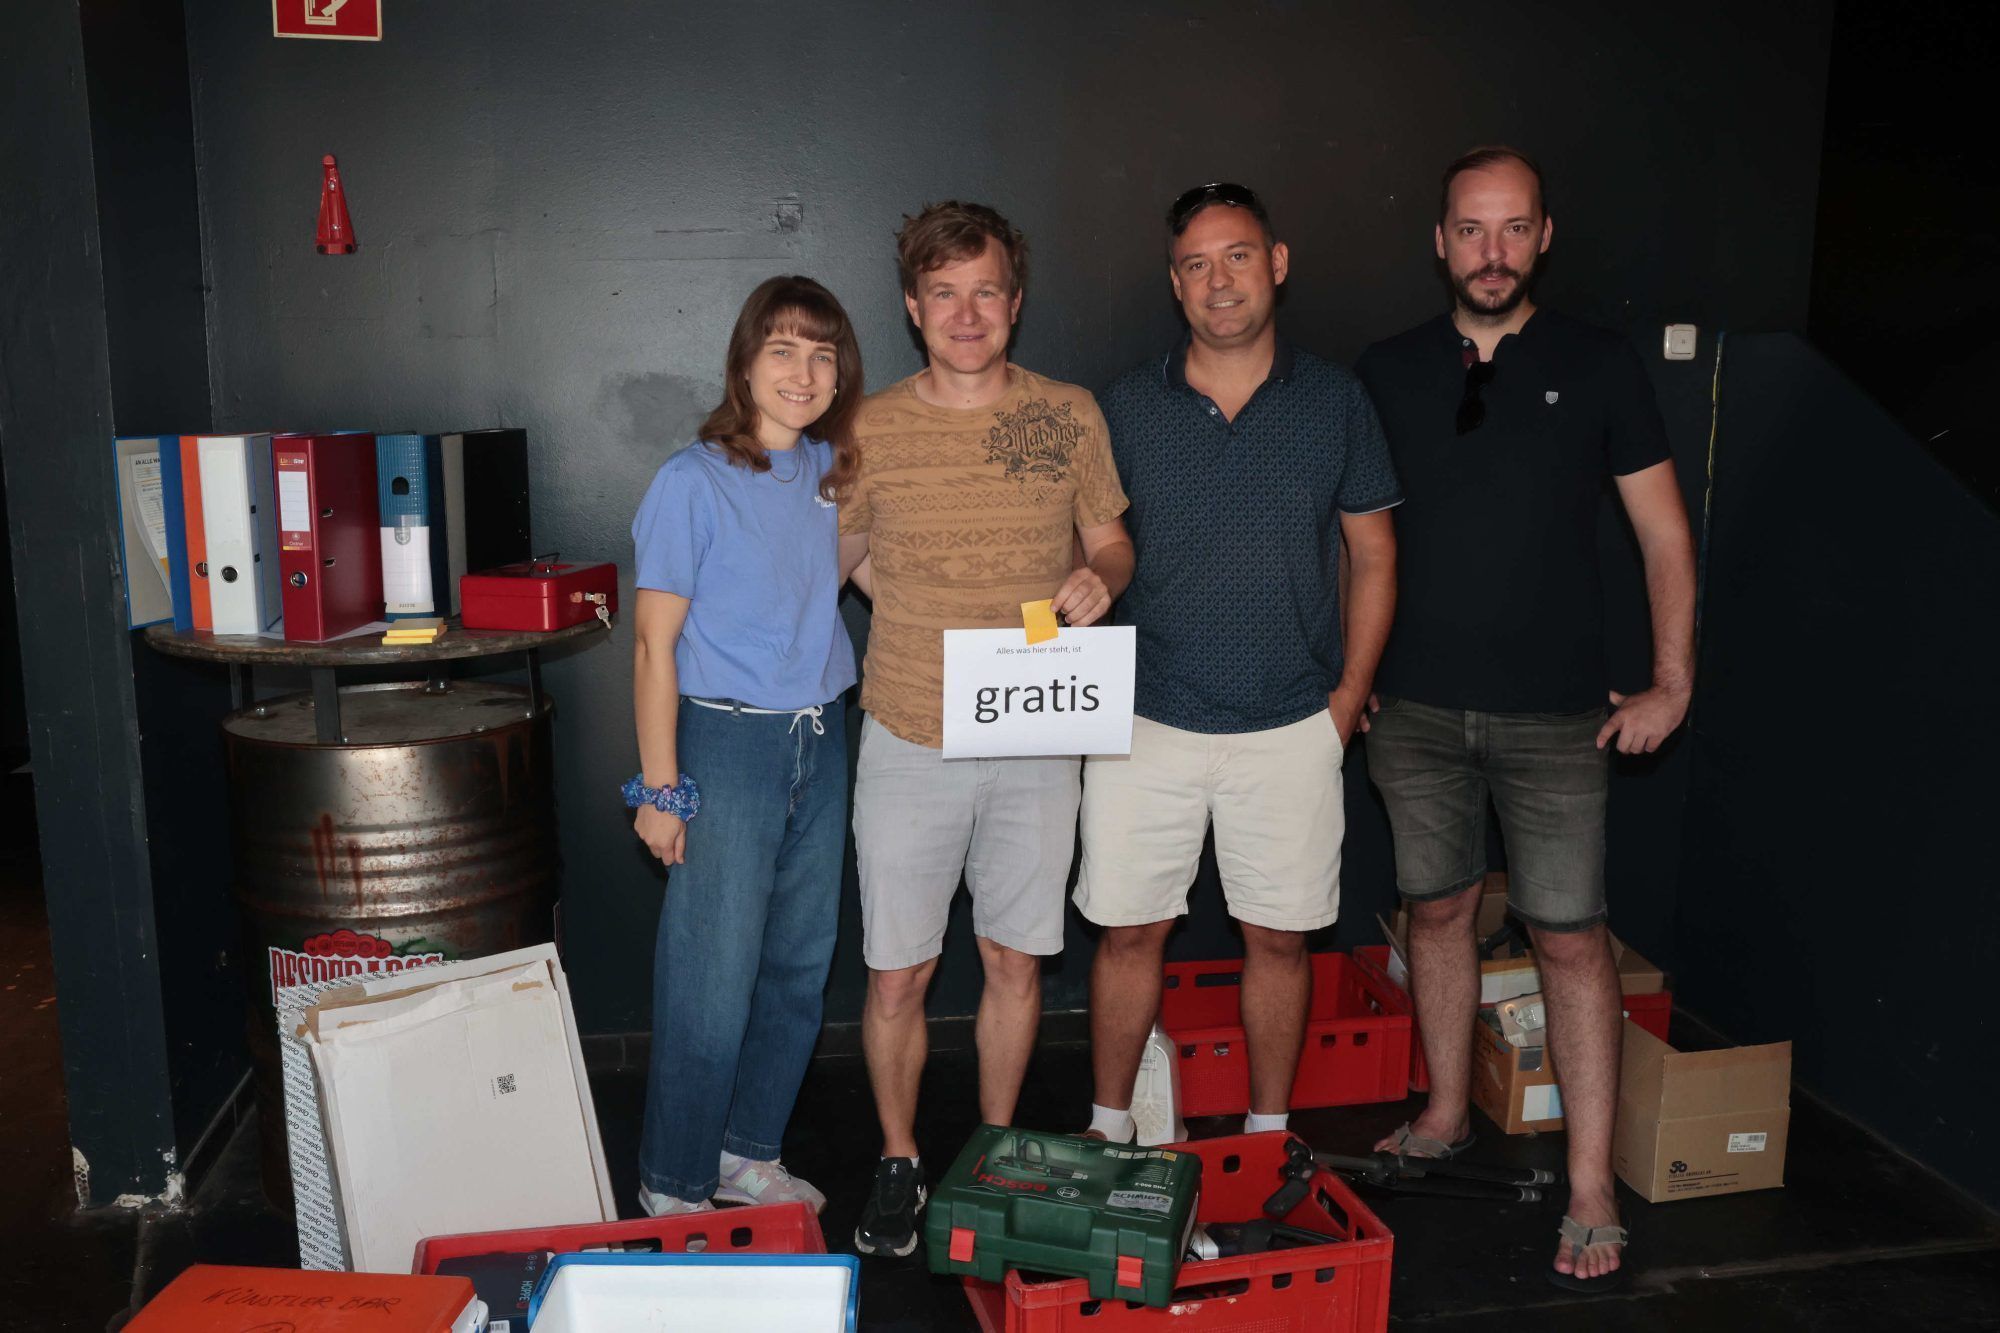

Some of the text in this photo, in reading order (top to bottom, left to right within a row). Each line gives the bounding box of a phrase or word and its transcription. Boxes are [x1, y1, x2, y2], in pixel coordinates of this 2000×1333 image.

[989, 421, 1078, 458] Billabong
[996, 647, 1014, 655] Alles
[1049, 645, 1071, 654] steht,
[975, 675, 1099, 723] gratis
[298, 994, 317, 1005] Optima
[292, 1076, 312, 1090] Optima
[290, 1103, 309, 1116] Optima
[303, 1137, 322, 1151] Optima
[293, 1150, 312, 1164] Optima
[300, 1164, 319, 1178] Optima
[978, 1172, 1048, 1192] BOSCH
[1112, 1192, 1170, 1204] SCHMIDTS
[312, 1199, 331, 1213] Optima
[302, 1212, 322, 1226] Optima
[310, 1226, 329, 1239] Optima
[300, 1239, 319, 1252] Optima
[519, 1280, 534, 1302] HOPPE
[200, 1287, 402, 1314] KÜNSTLER BAR
